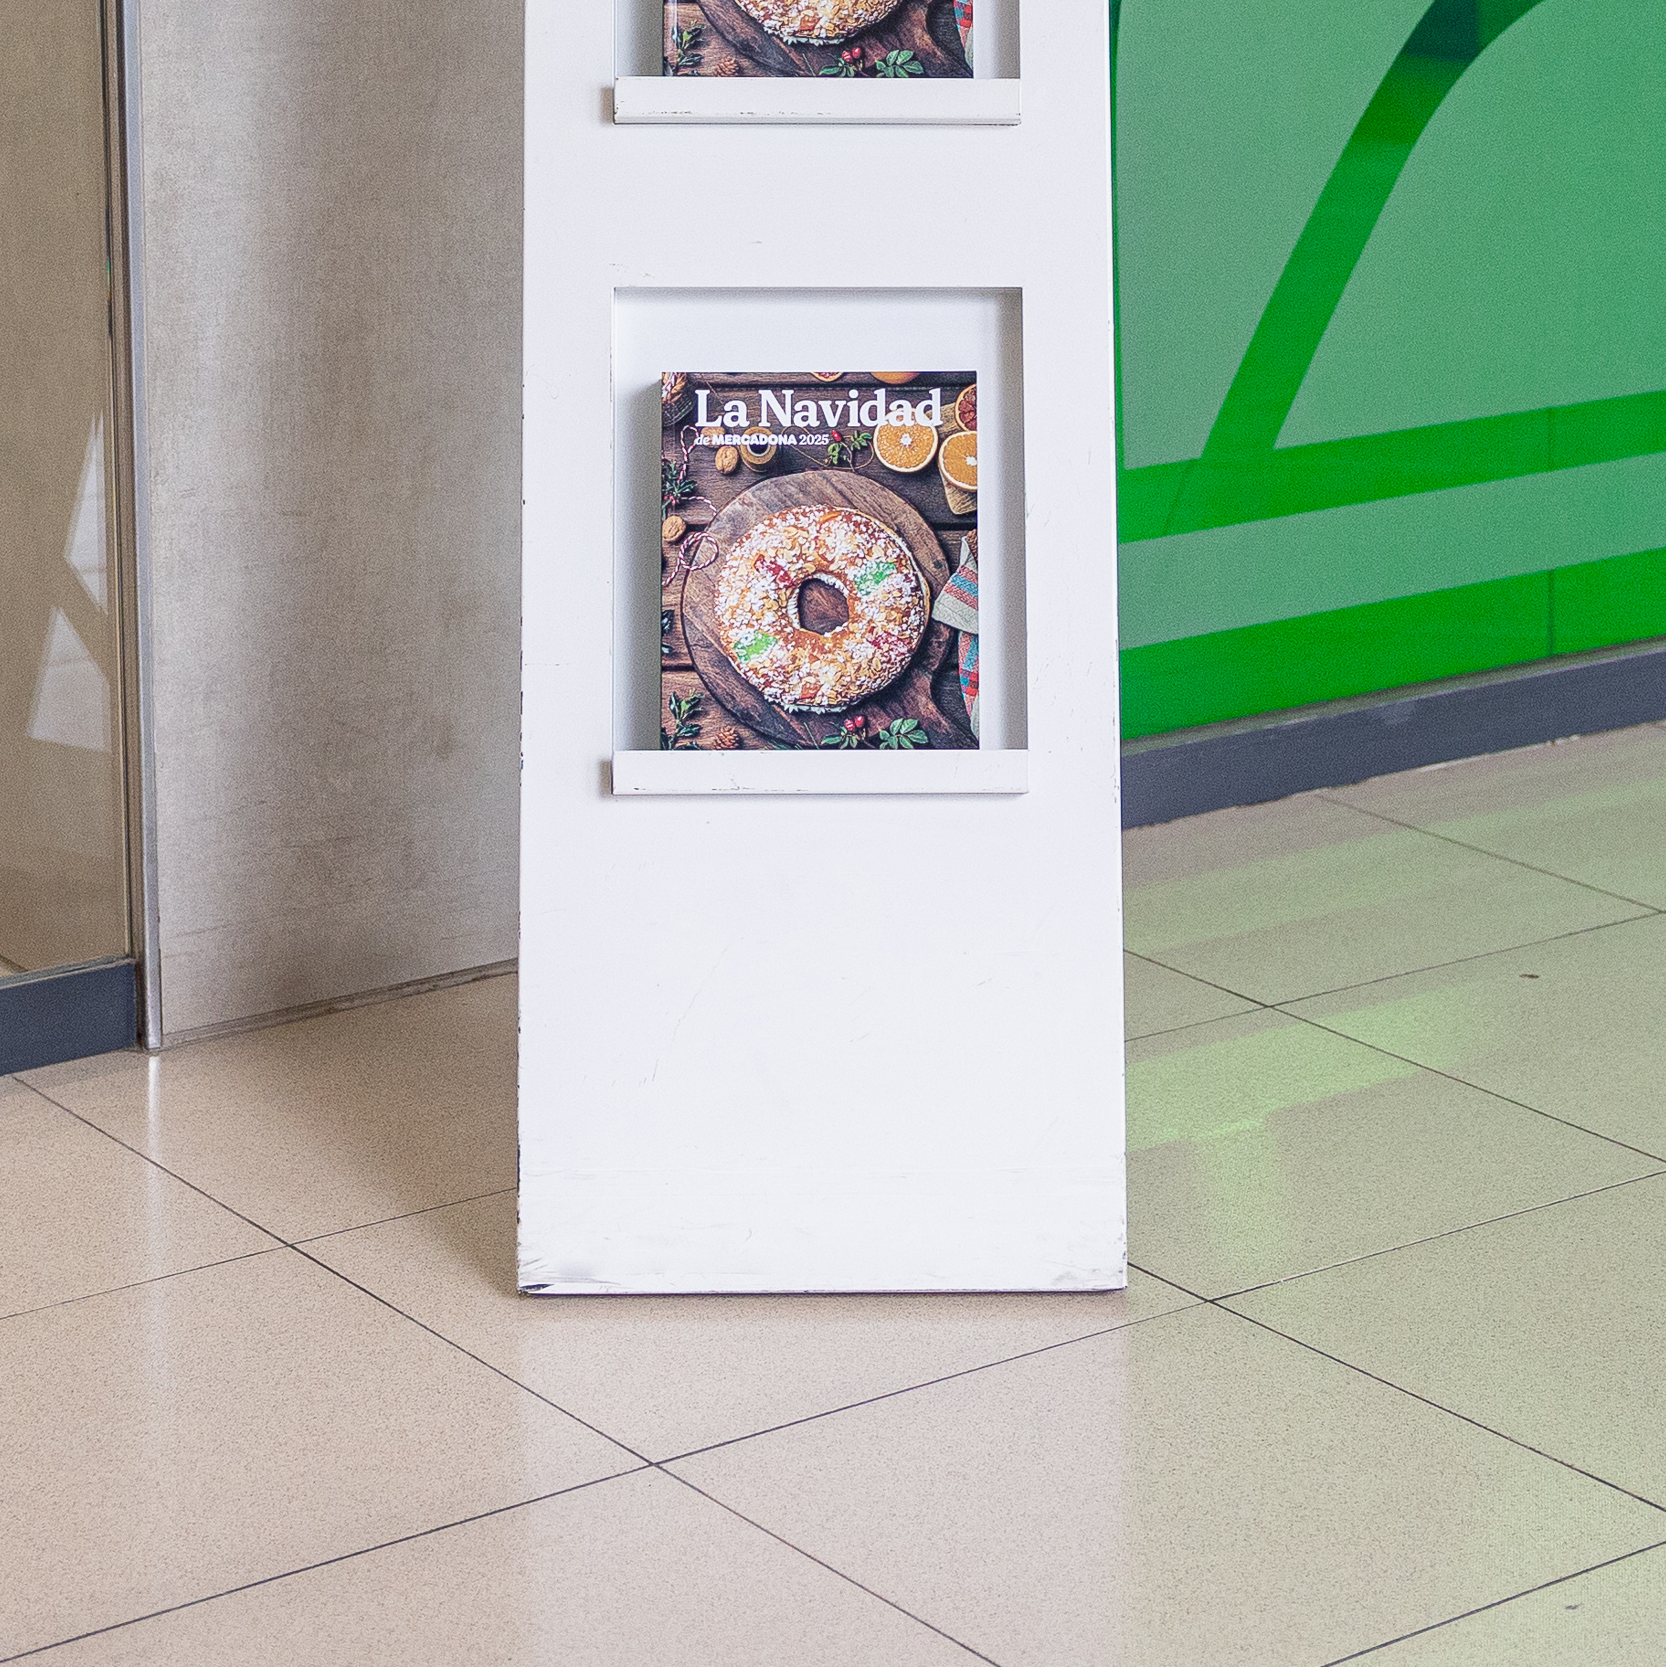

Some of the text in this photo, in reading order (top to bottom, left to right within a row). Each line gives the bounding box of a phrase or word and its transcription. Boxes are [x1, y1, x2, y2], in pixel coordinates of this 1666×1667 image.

[695, 388, 943, 427] La Navidad
[695, 435, 829, 445] de MERCADONA 2025
